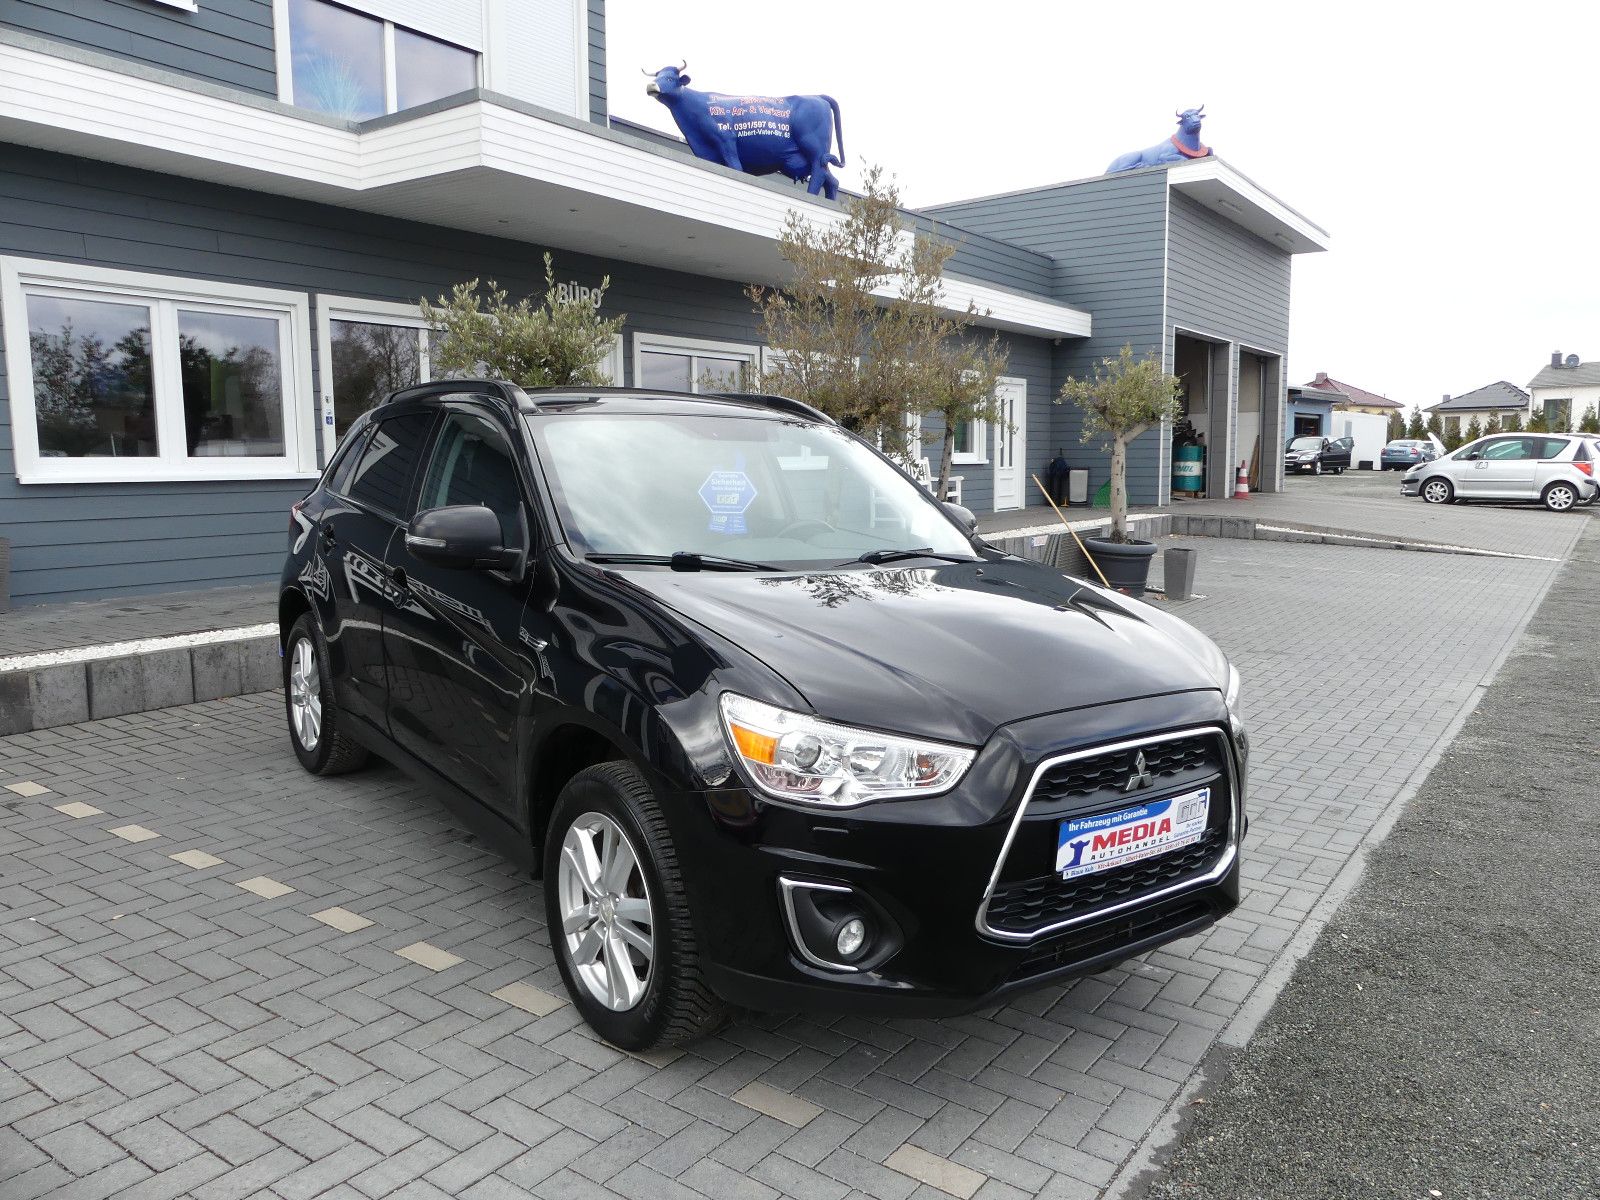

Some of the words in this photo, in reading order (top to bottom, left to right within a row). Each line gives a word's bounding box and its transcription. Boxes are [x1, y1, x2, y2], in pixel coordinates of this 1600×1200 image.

[718, 123, 732, 131] Tel.
[734, 121, 766, 130] 0391/597
[556, 280, 602, 309] BÜRO
[1068, 823, 1079, 832] Ihr
[1079, 816, 1111, 830] Fahrzeug
[1111, 813, 1122, 824] mit
[1123, 808, 1148, 821] Garantie
[1091, 817, 1172, 852] MEDIA
[1090, 835, 1171, 861] AUTOHANDEL
